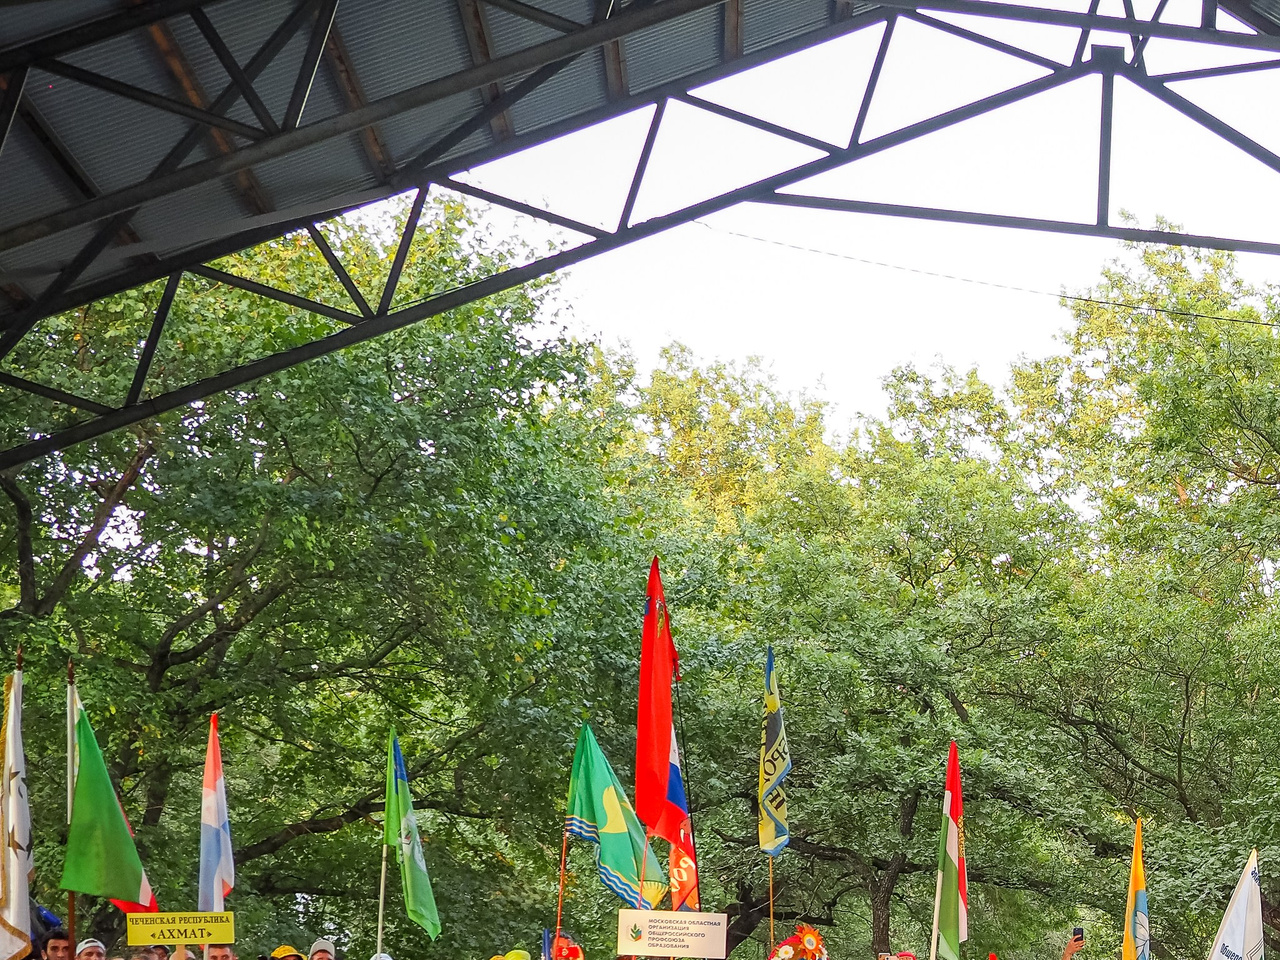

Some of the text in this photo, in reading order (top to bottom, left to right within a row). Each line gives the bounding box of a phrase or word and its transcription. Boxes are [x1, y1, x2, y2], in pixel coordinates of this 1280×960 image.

[129, 915, 230, 925] ЧЕЧЕНСКАЯ РЕСПУБЛИКА
[150, 928, 213, 940] «АХМАТ»
